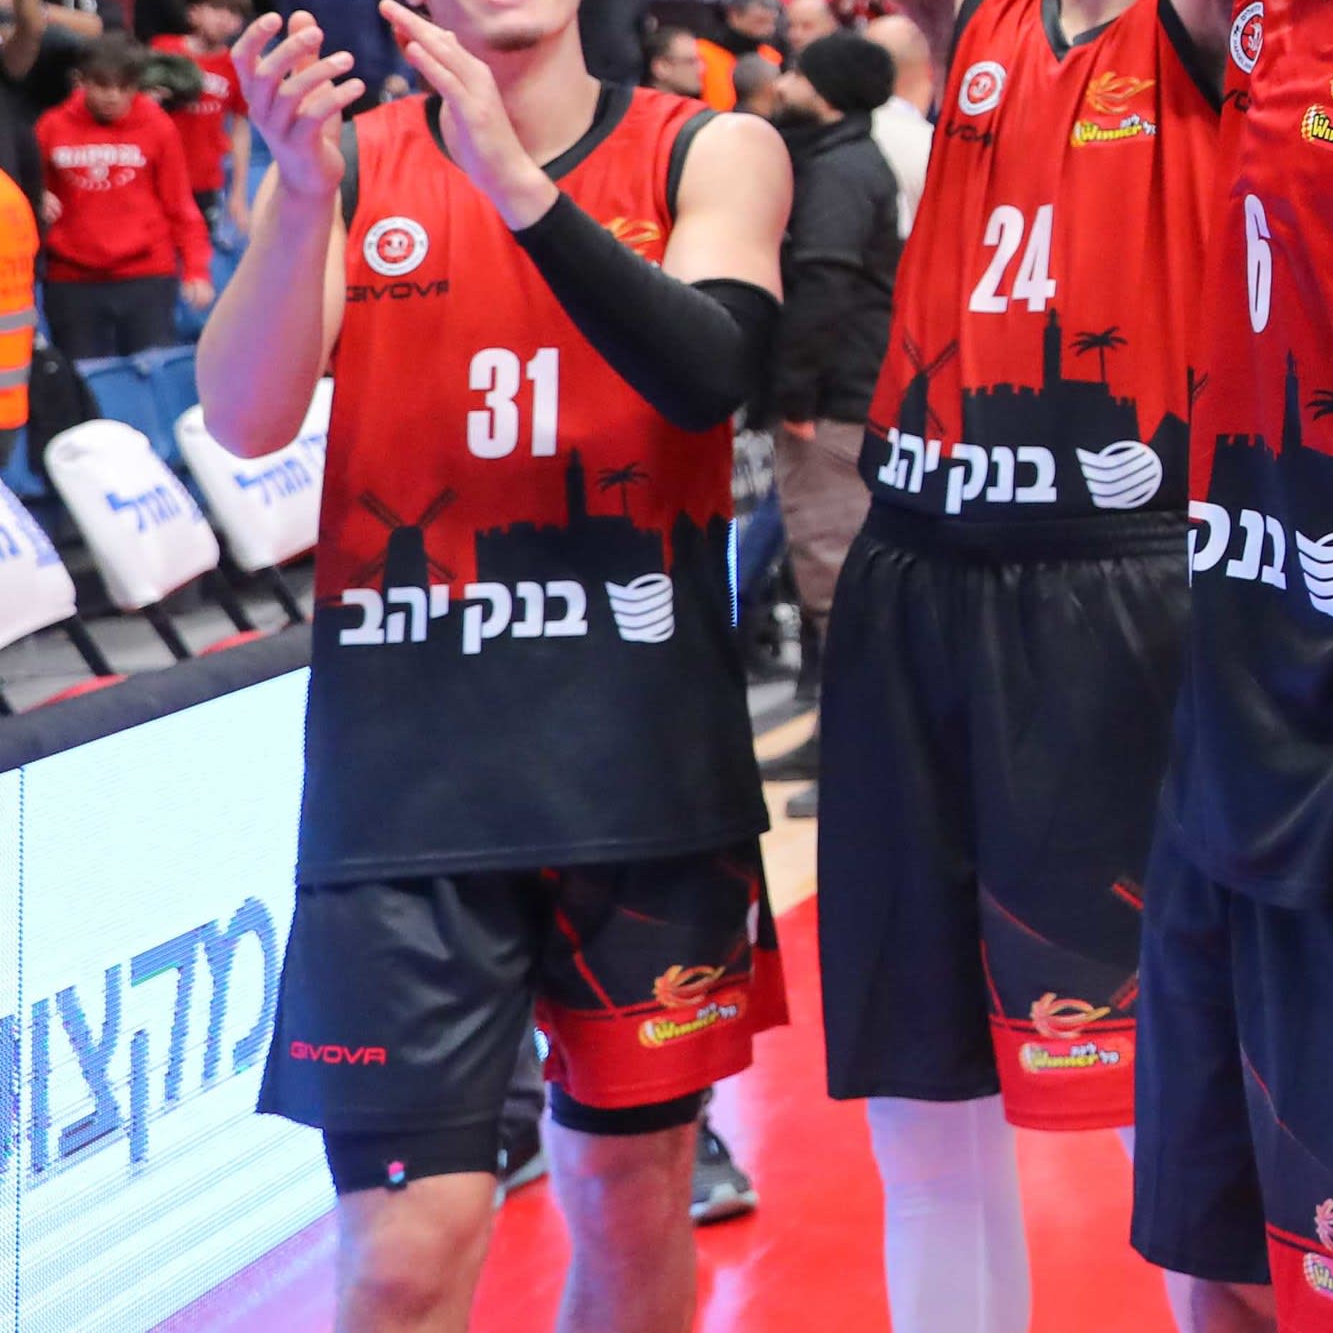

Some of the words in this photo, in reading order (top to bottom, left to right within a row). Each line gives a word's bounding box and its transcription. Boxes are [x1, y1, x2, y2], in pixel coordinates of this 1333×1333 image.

[968, 204, 1057, 313] 24
[1245, 194, 1271, 333] 6
[467, 348, 559, 459] 31
[945, 443, 1057, 515] בנק
[1187, 499, 1287, 590] בנק
[339, 583, 450, 646] יהב
[462, 580, 588, 654] בנק
[0, 896, 281, 1179] מקצו
